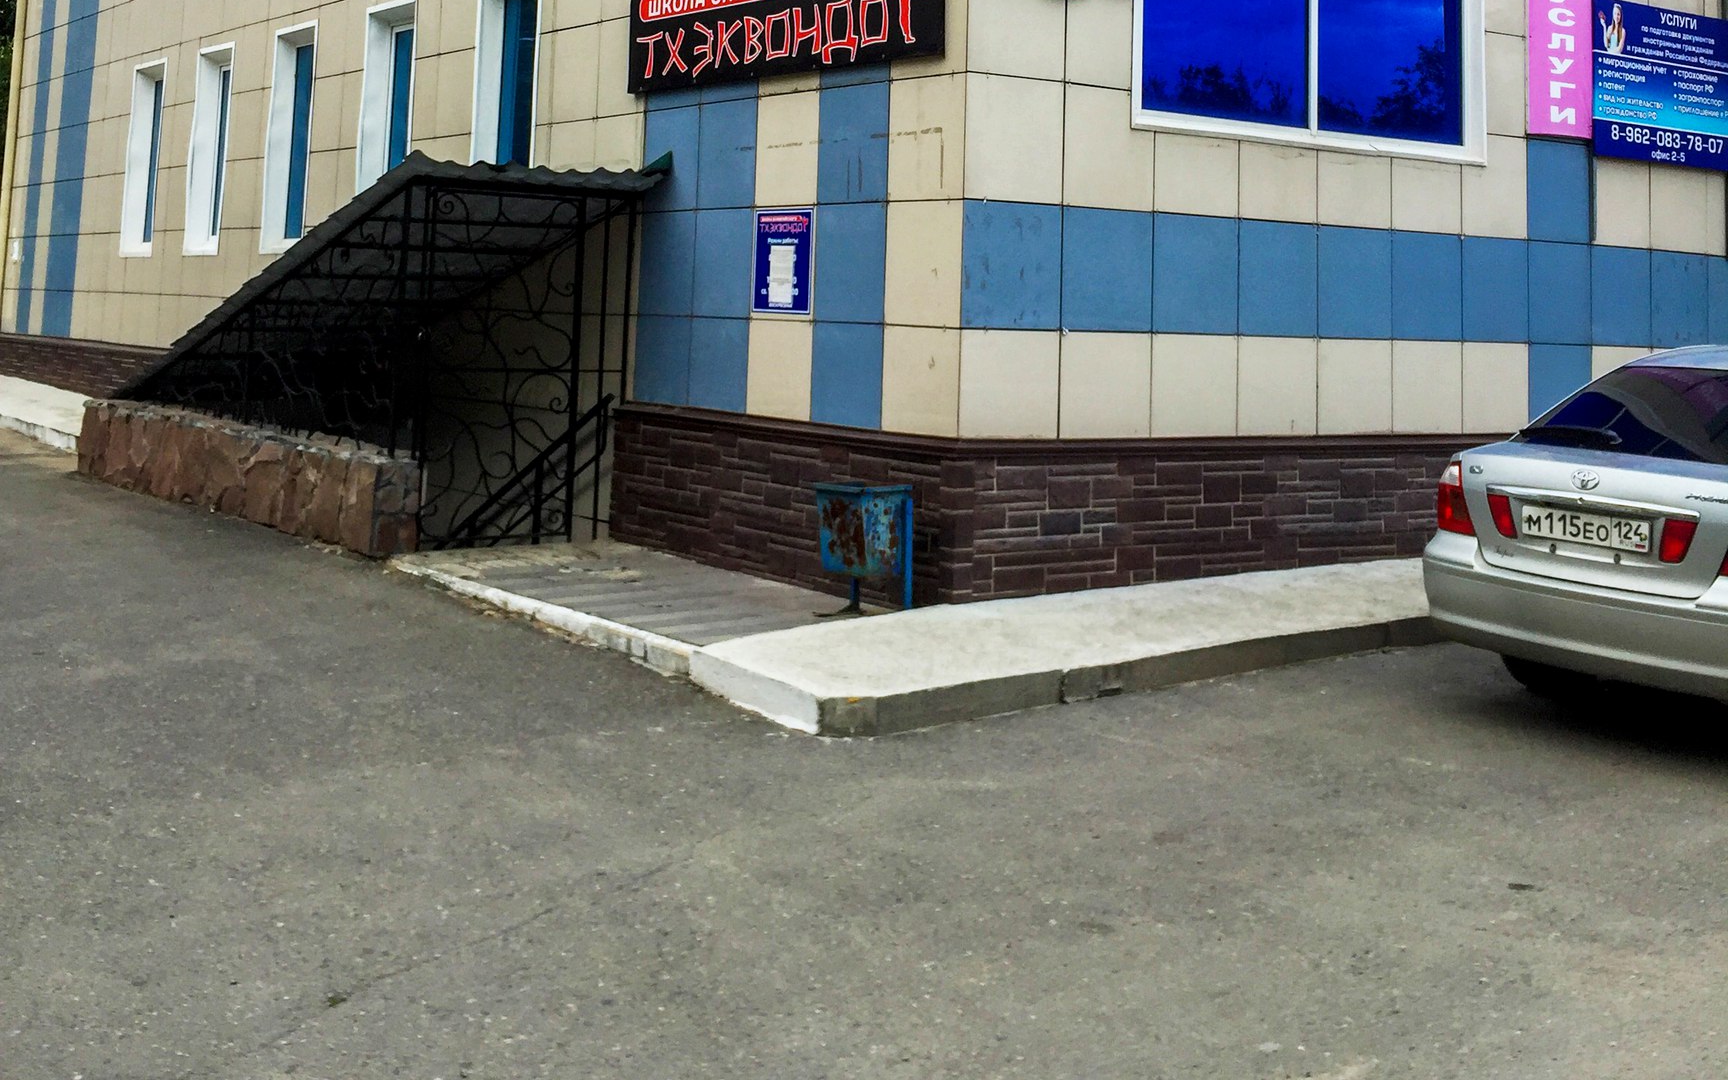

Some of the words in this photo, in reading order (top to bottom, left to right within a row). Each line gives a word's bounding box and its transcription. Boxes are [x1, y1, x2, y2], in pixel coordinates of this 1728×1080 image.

[1660, 12, 1697, 30] УСЛУГИ
[1603, 57, 1652, 72] миграционный
[1652, 65, 1667, 74] учет
[1603, 70, 1646, 83] регистрация
[1678, 70, 1718, 83] страхование
[1603, 82, 1625, 91] патент
[1678, 82, 1704, 93] паспорт
[1705, 84, 1714, 93] РФ
[1611, 124, 1724, 154] 8-962-083-78-07
[1651, 149, 1671, 162] офис
[1671, 151, 1685, 162] 2-5
[1526, 512, 1609, 542] М115ЕО
